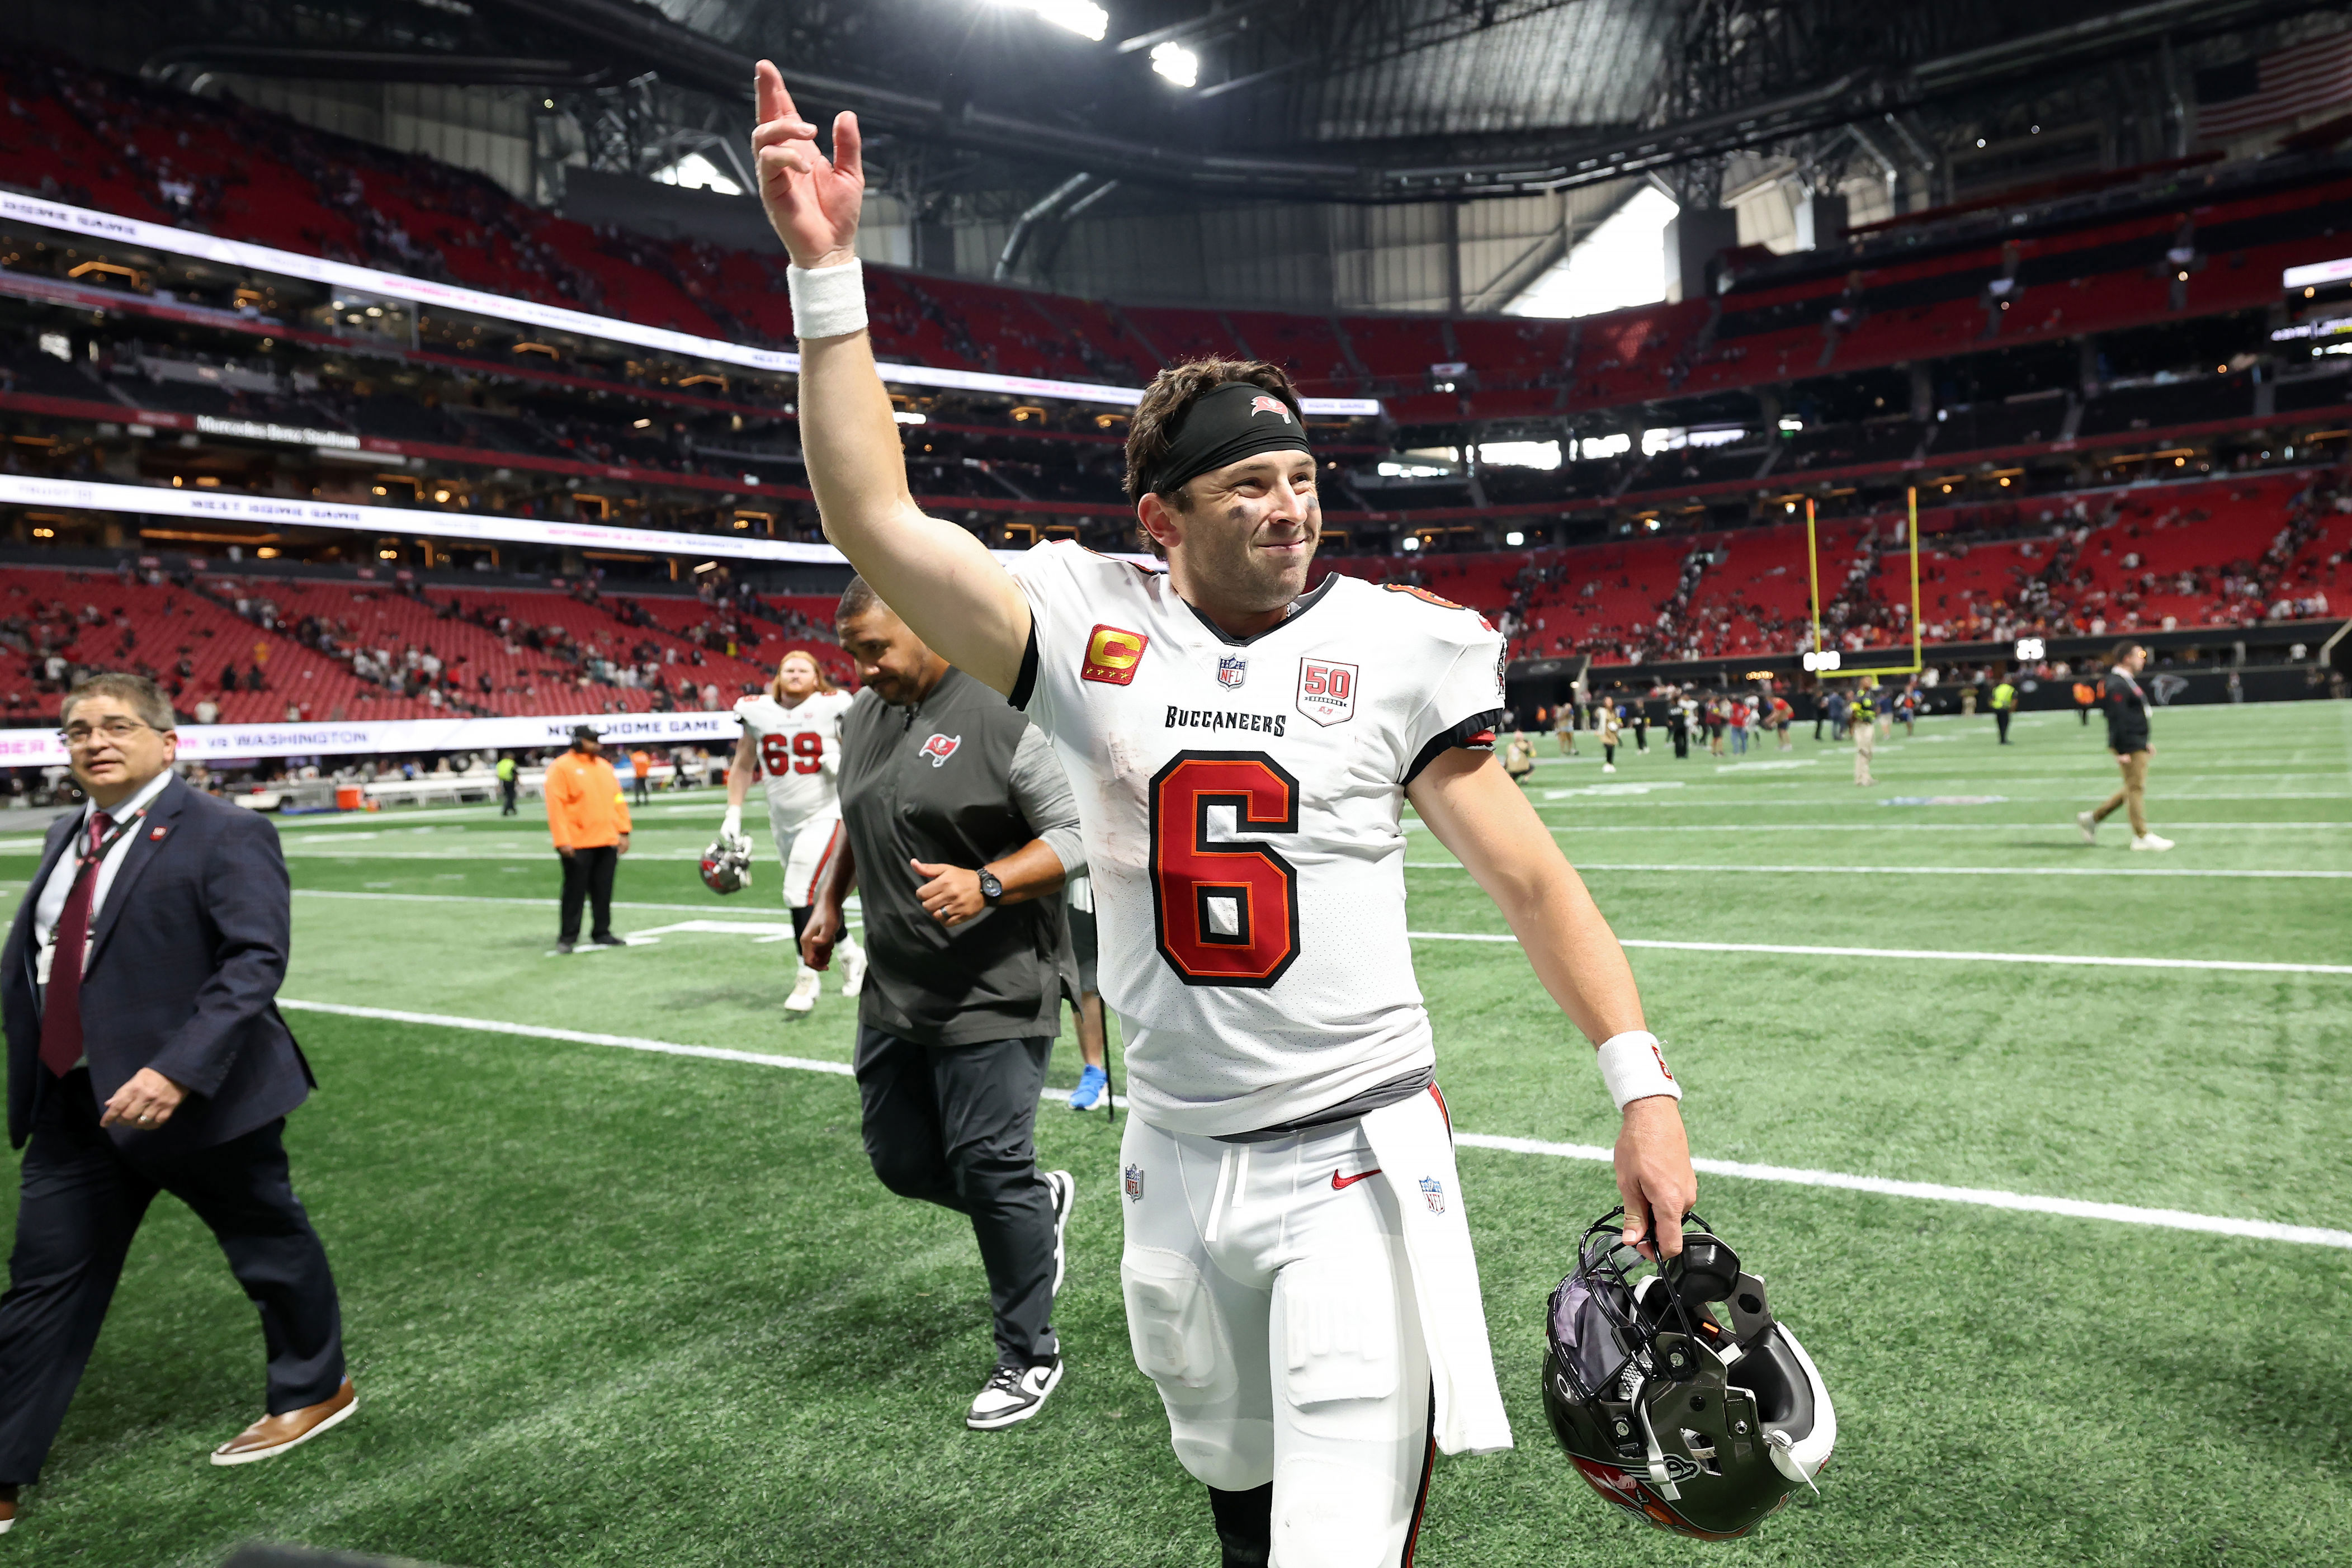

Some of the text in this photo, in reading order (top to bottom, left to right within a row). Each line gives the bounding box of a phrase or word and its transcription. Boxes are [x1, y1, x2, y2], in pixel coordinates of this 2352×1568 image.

[303, 428, 360, 450] Stadium
[1090, 630, 1141, 669] C
[1220, 669, 1241, 683] NFL
[1305, 664, 1350, 700] 50
[1311, 697, 1341, 706] SEASONS
[669, 719, 719, 733] GAME
[234, 731, 368, 746] WASHINGTON
[762, 731, 823, 776] 69
[1149, 749, 1301, 989] 6
[1127, 1179, 1139, 1194] NFL
[1425, 1193, 1443, 1211] NFL
